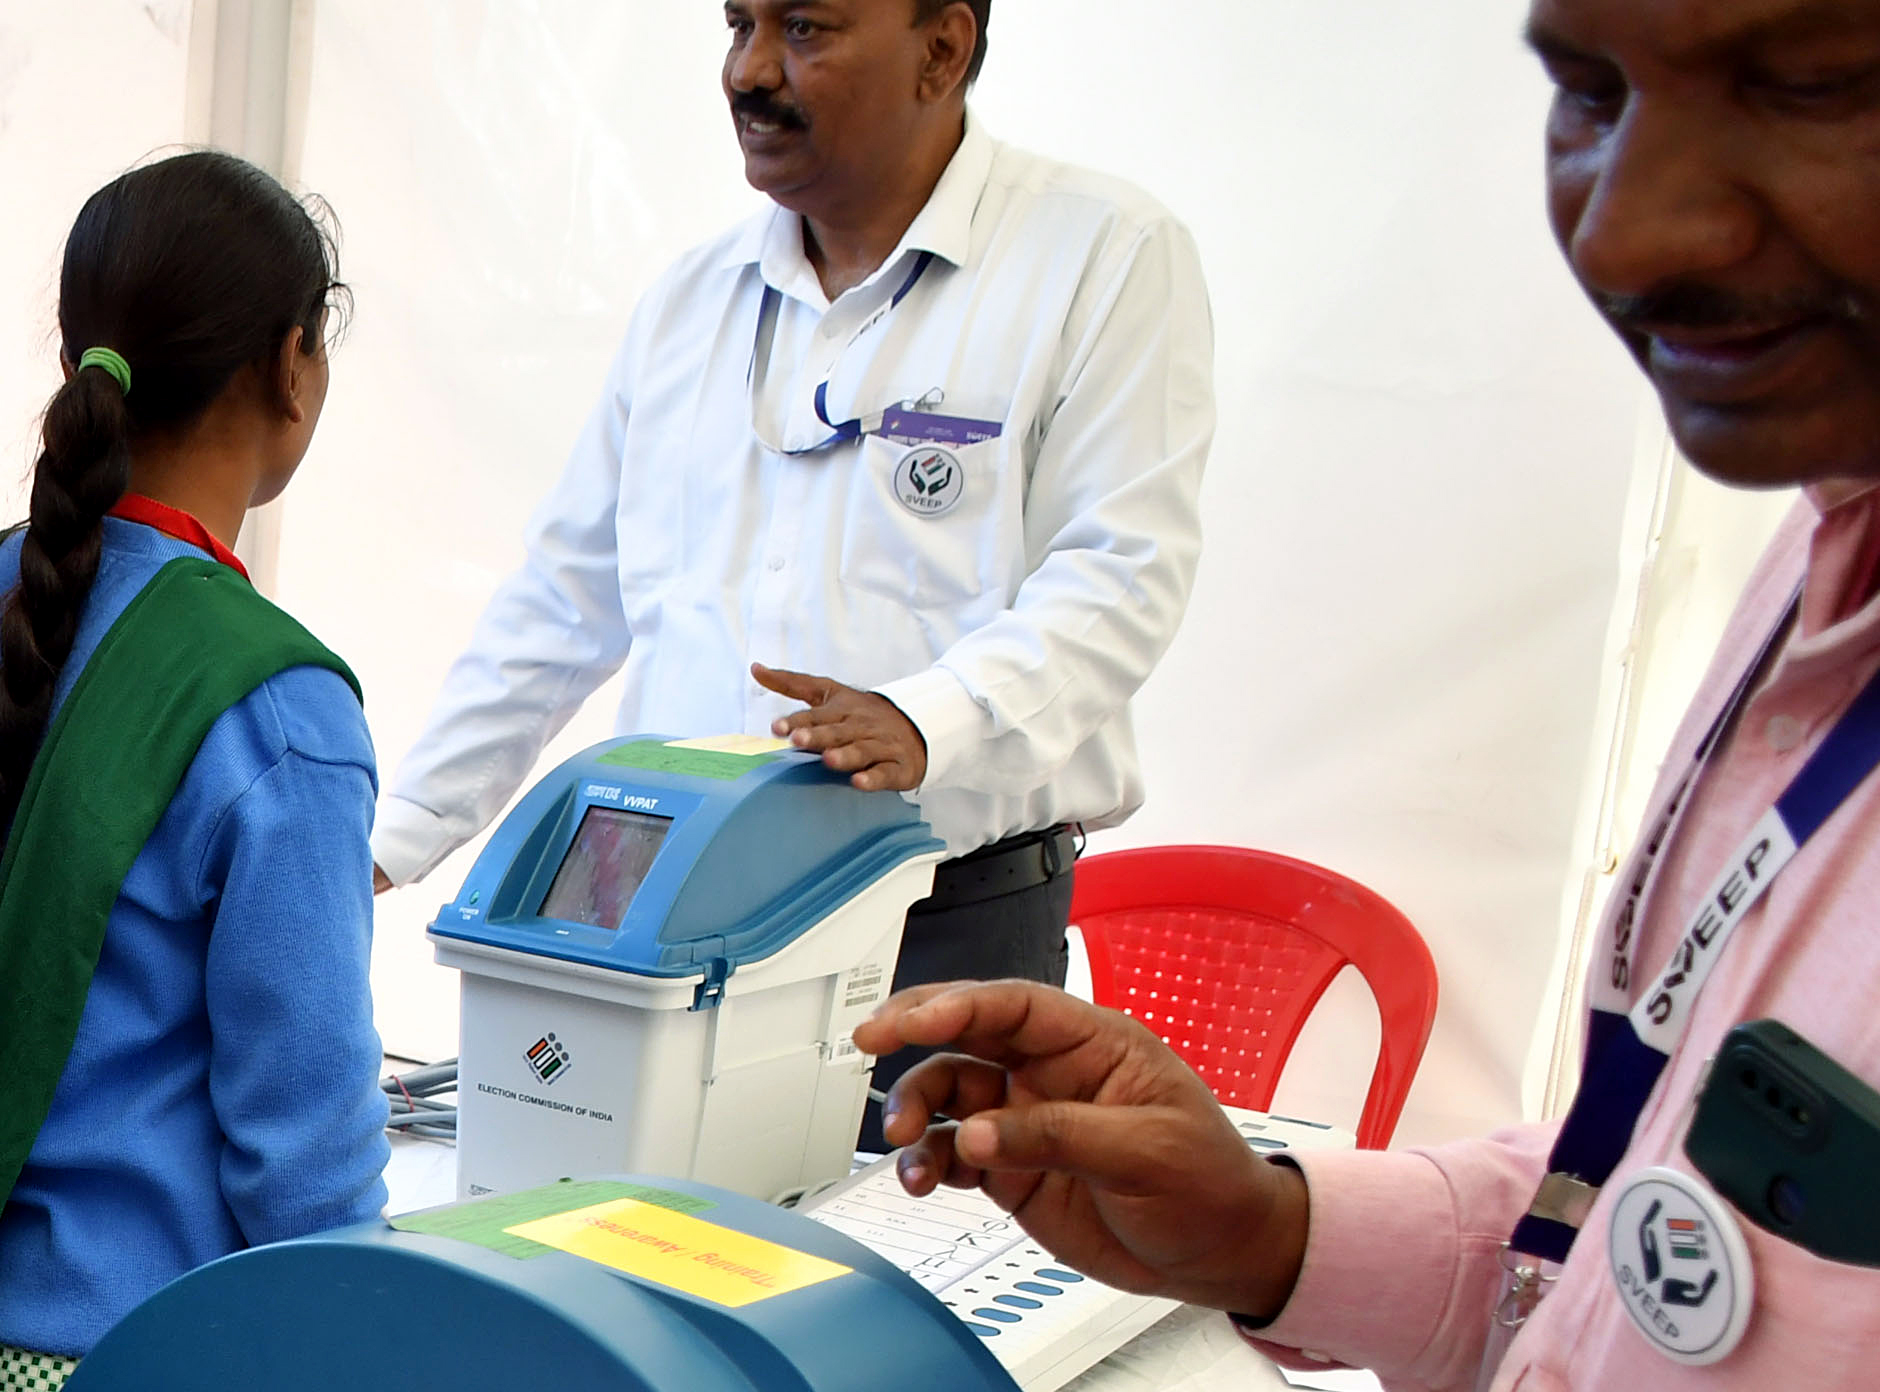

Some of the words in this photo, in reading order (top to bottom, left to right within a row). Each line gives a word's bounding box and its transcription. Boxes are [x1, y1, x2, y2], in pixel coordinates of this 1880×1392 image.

[905, 494, 942, 509] SVEEP
[623, 795, 658, 810] VVPAT
[1647, 838, 1769, 1025] SVEEP
[478, 1083, 516, 1099] ELECTION
[518, 1094, 573, 1113] COMMISSION
[575, 1107, 587, 1116] OF
[589, 1110, 613, 1122] INDIA
[1620, 1264, 1680, 1338] SVEEP
